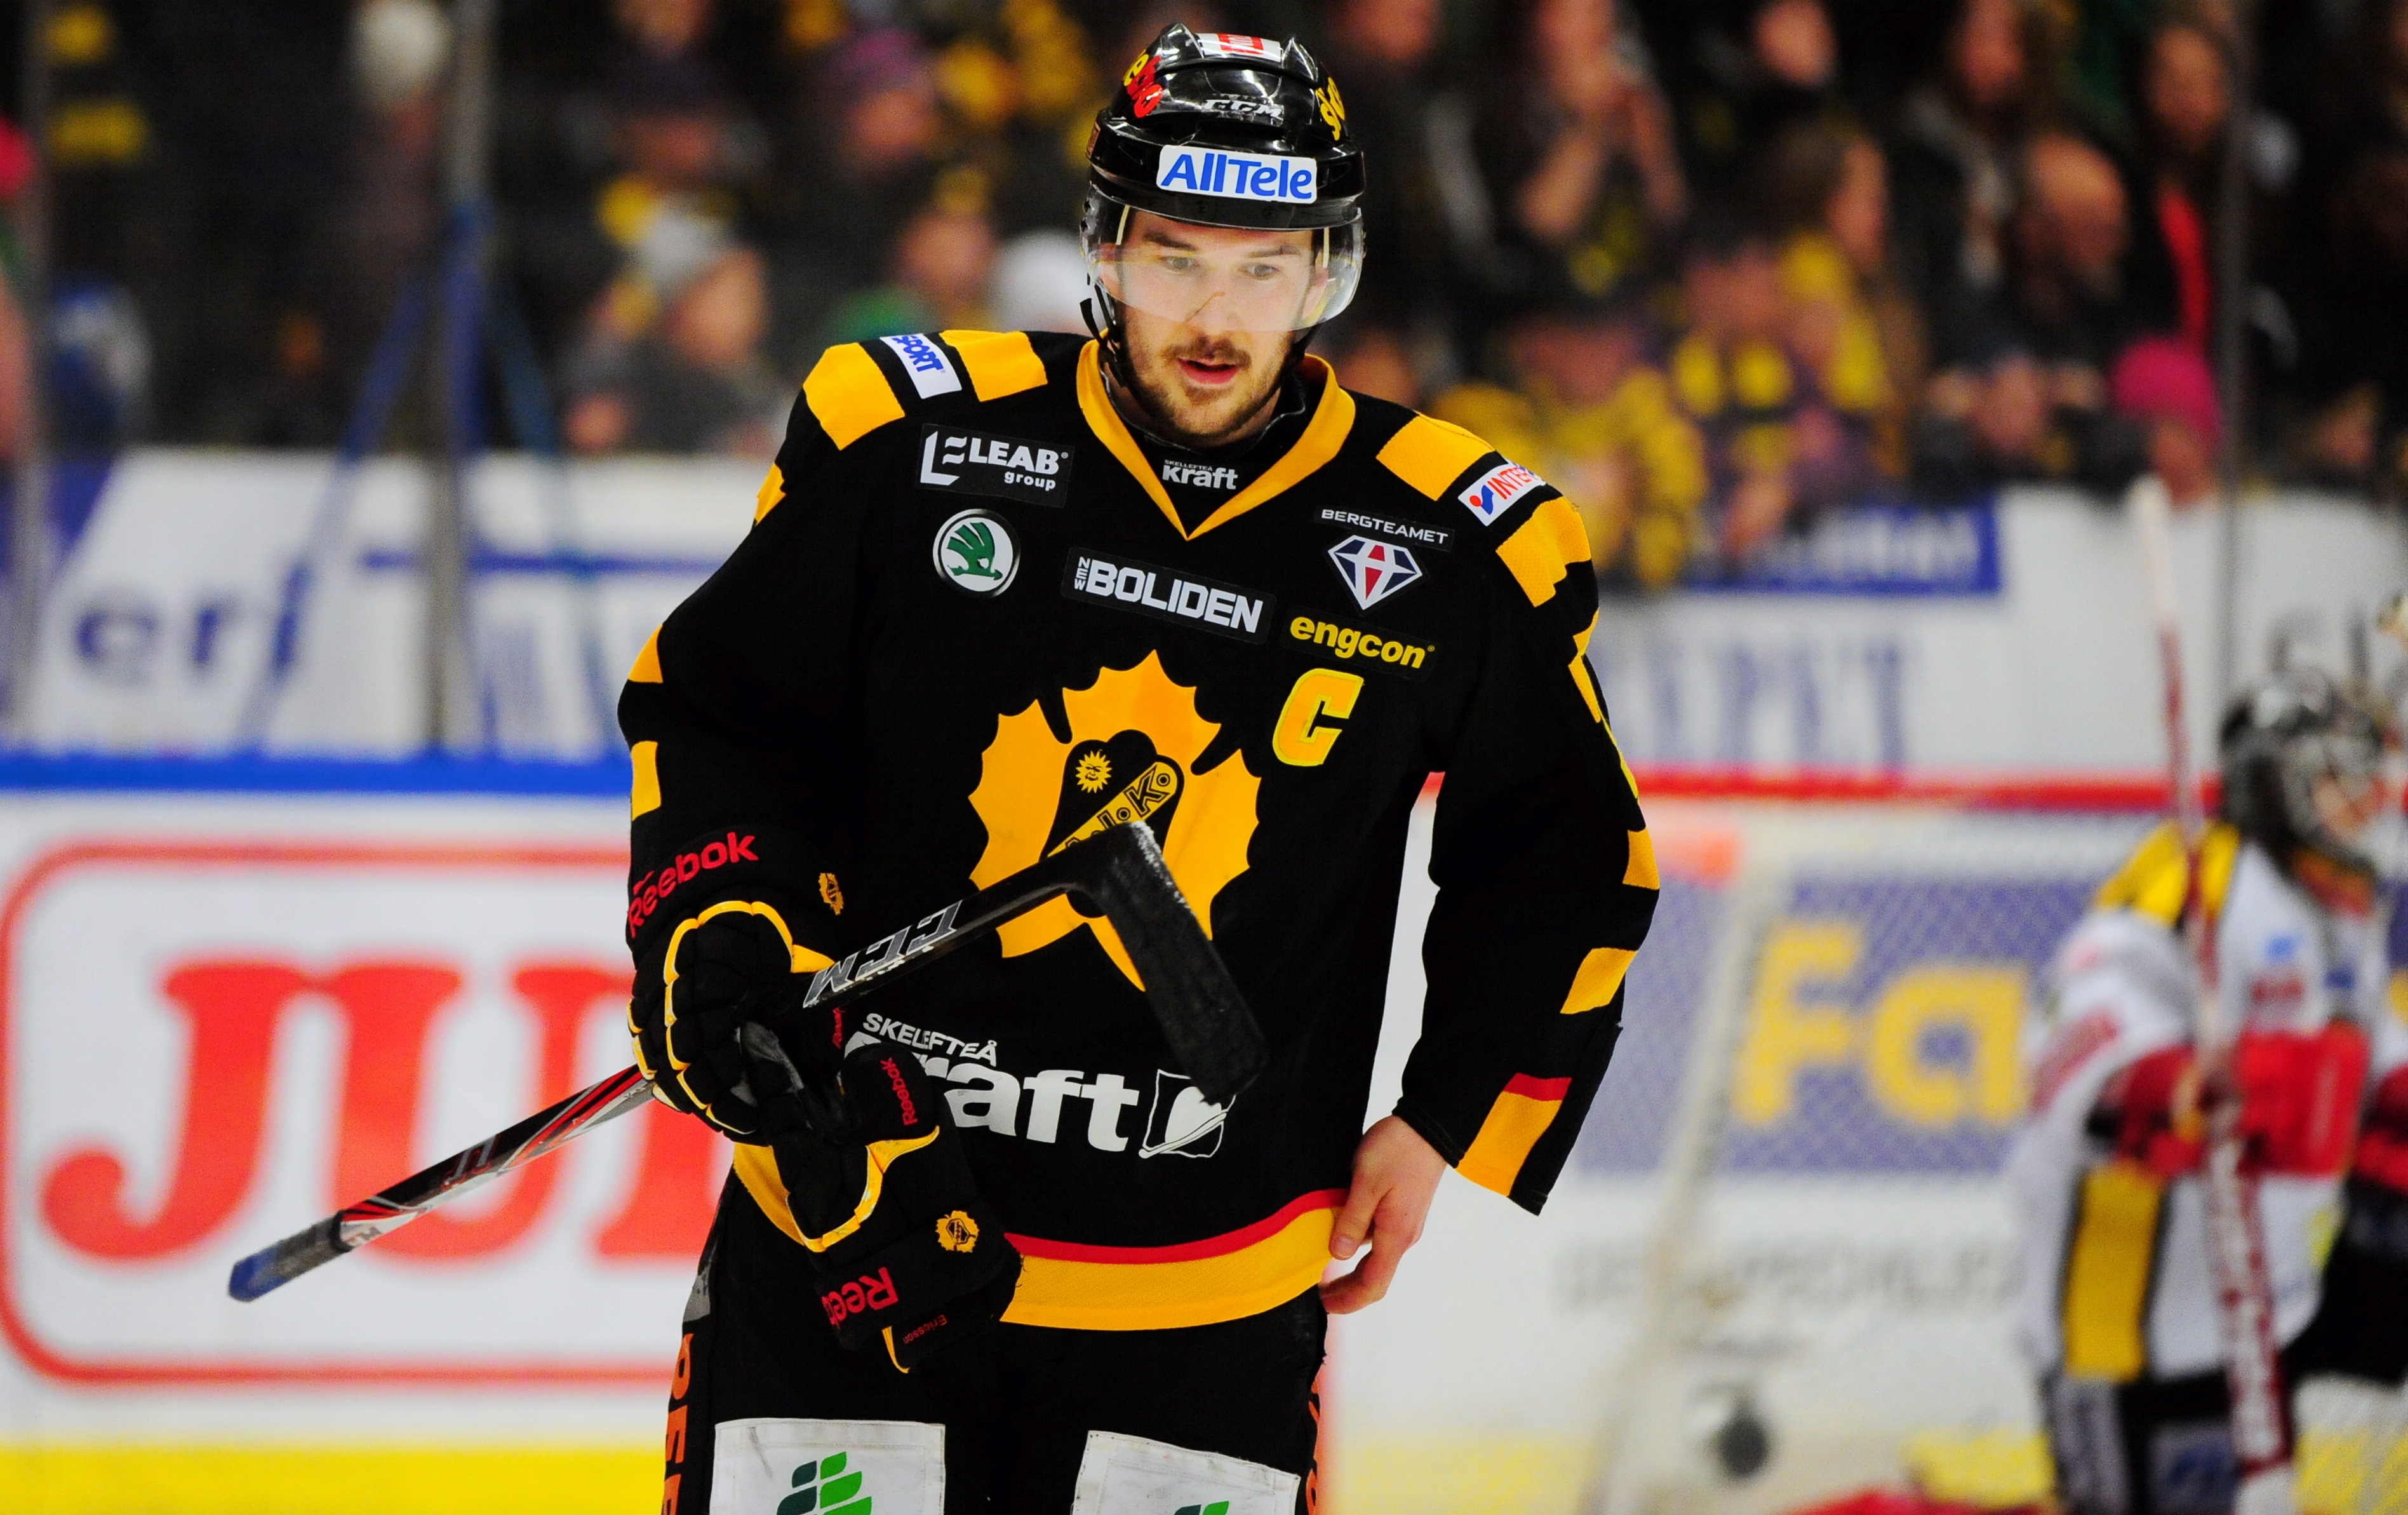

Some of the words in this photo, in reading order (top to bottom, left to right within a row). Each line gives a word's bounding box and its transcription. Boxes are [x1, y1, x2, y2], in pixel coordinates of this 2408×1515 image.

[1161, 152, 1313, 199] AllTele
[968, 437, 1059, 475] LEAB
[1162, 464, 1238, 490] kraft
[1004, 471, 1056, 492] group
[1321, 508, 1448, 544] BERGTEAMET
[1074, 556, 1090, 591] NEW
[1085, 559, 1264, 633] BOLIDEN
[1290, 616, 1426, 669] engcon
[1272, 668, 1365, 767] C
[627, 831, 759, 938] Reebok
[802, 899, 963, 1009] CCM
[880, 1056, 918, 1126] Reebok
[902, 1314, 948, 1345] Ericsson
